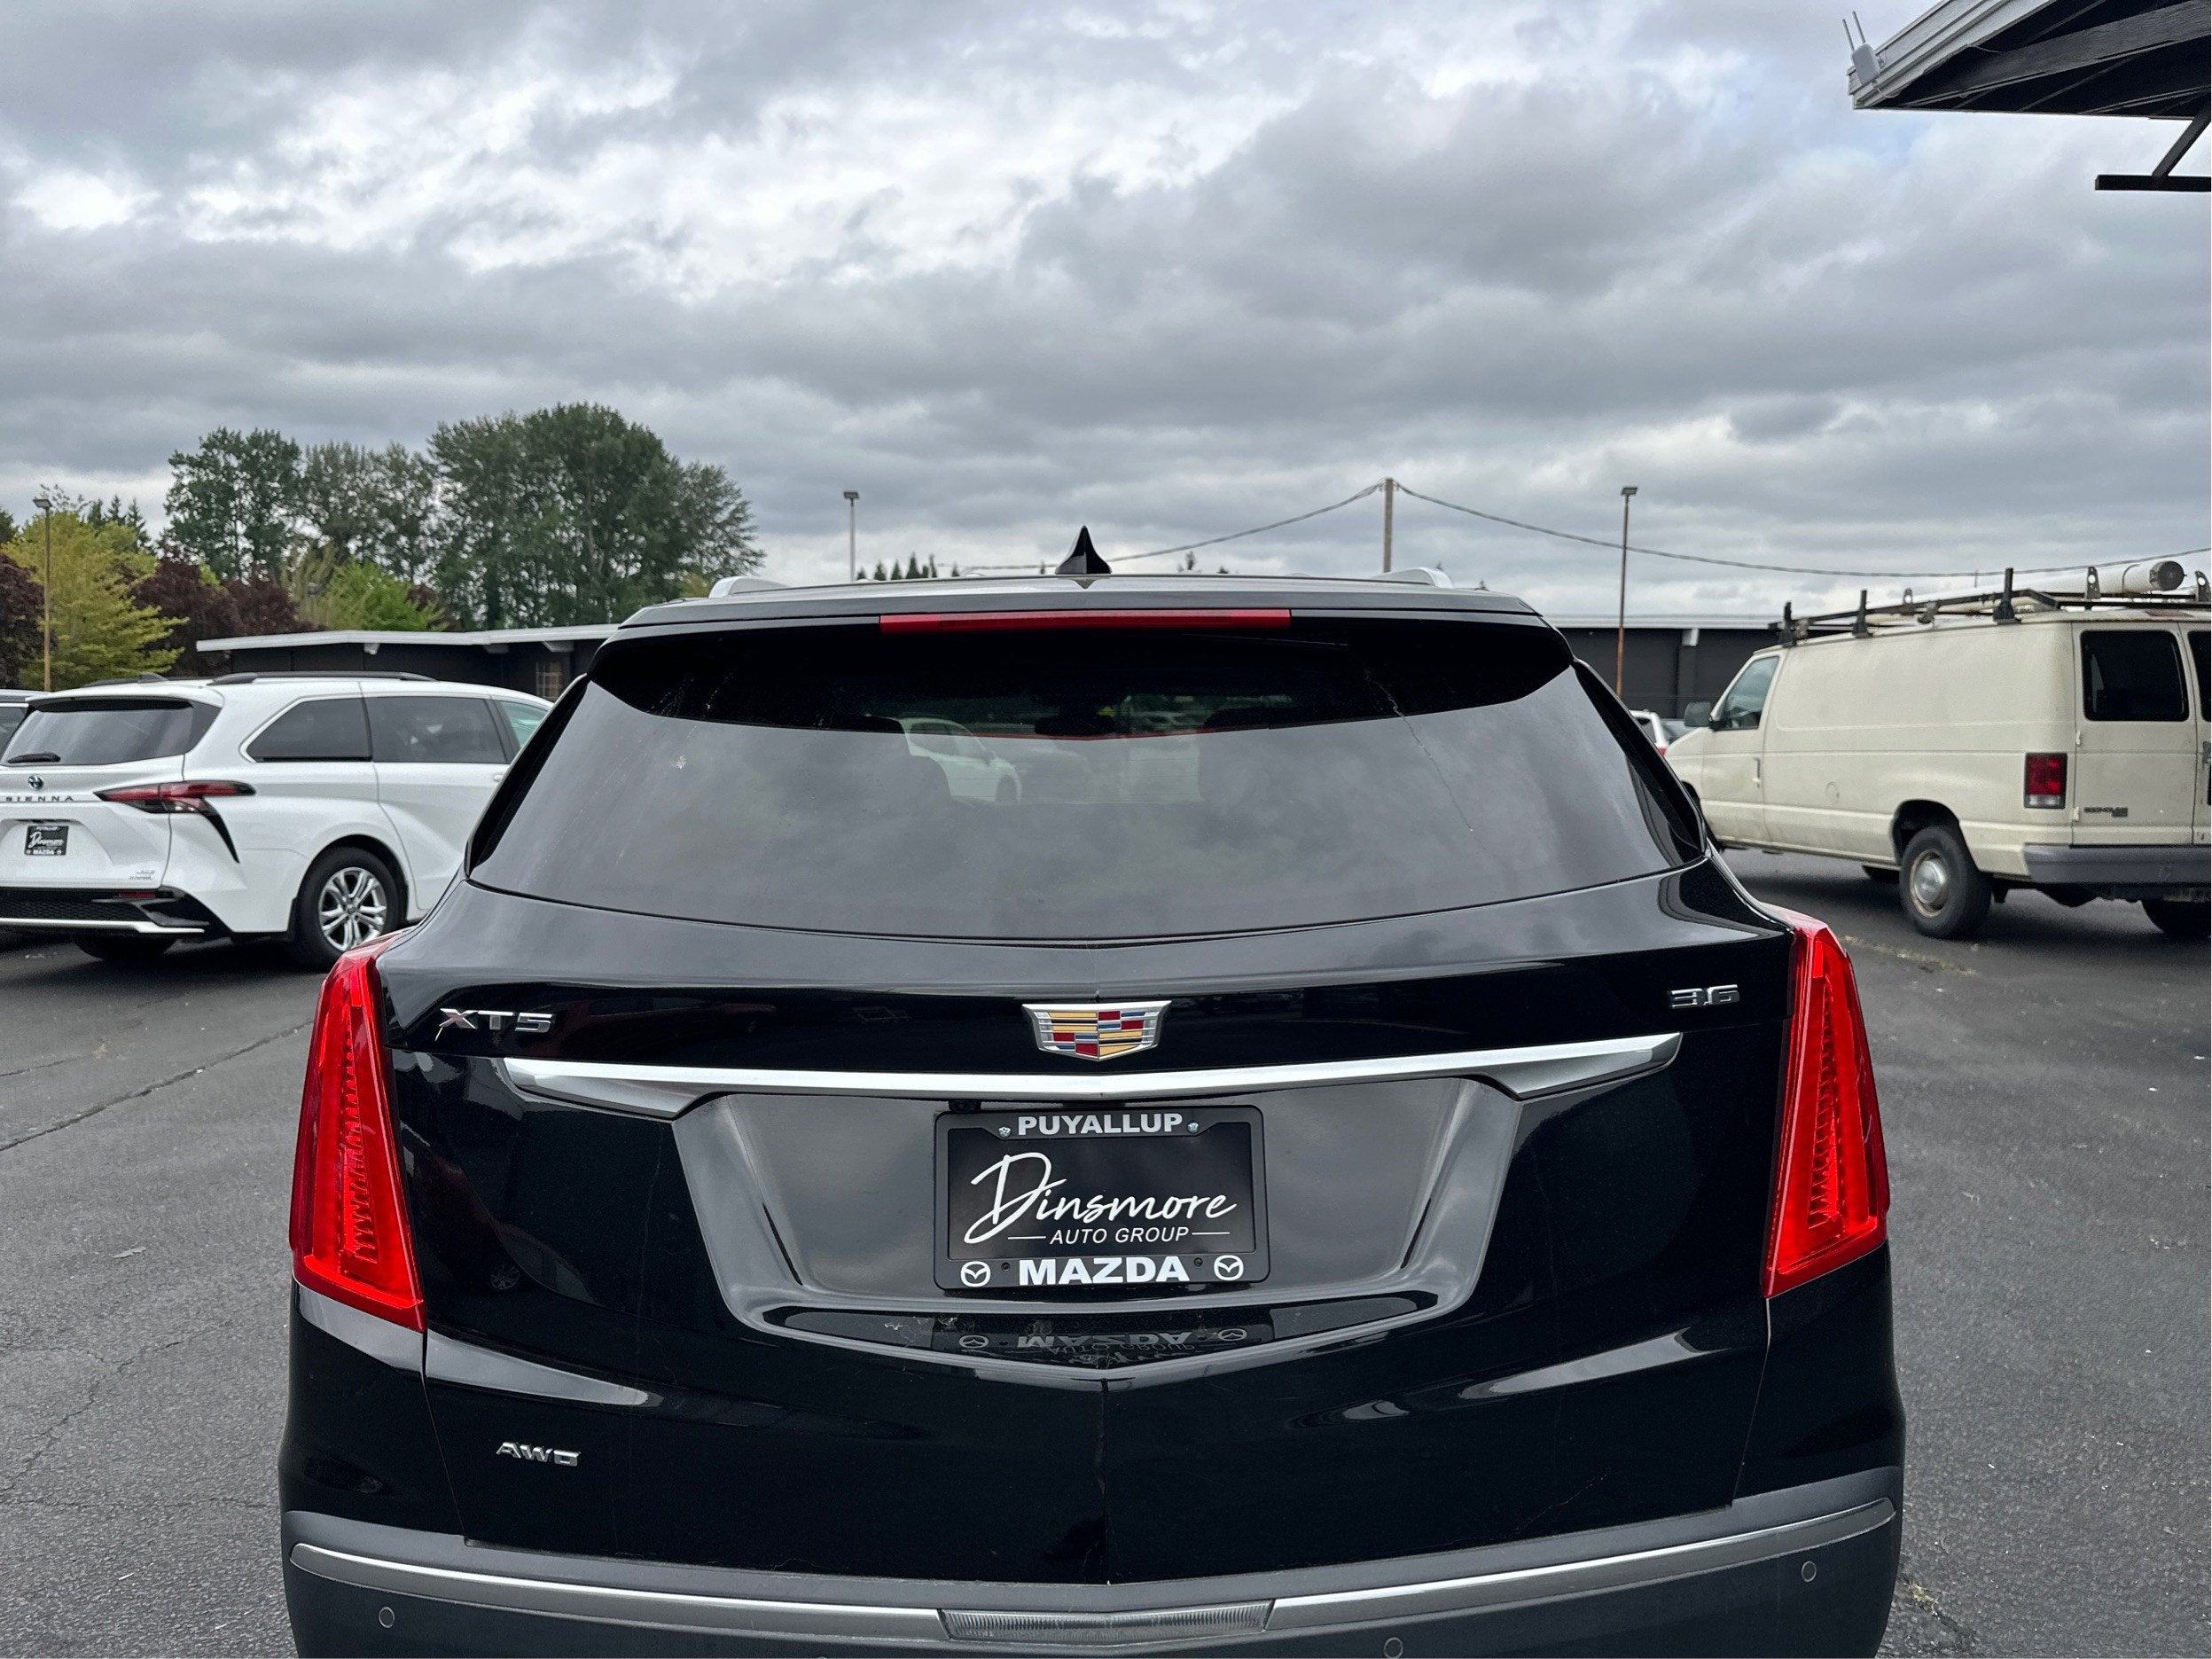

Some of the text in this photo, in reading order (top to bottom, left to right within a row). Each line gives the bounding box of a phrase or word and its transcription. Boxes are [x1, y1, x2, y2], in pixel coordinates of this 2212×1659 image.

[436, 1008, 553, 1035] XT5
[1019, 1113, 1183, 1136] PUYALLUP
[964, 1152, 1237, 1244] Dinsmore
[1050, 1226, 1189, 1245] AUTO GROUP
[1019, 1256, 1190, 1286] MAZDA
[496, 1442, 580, 1467] AWD
